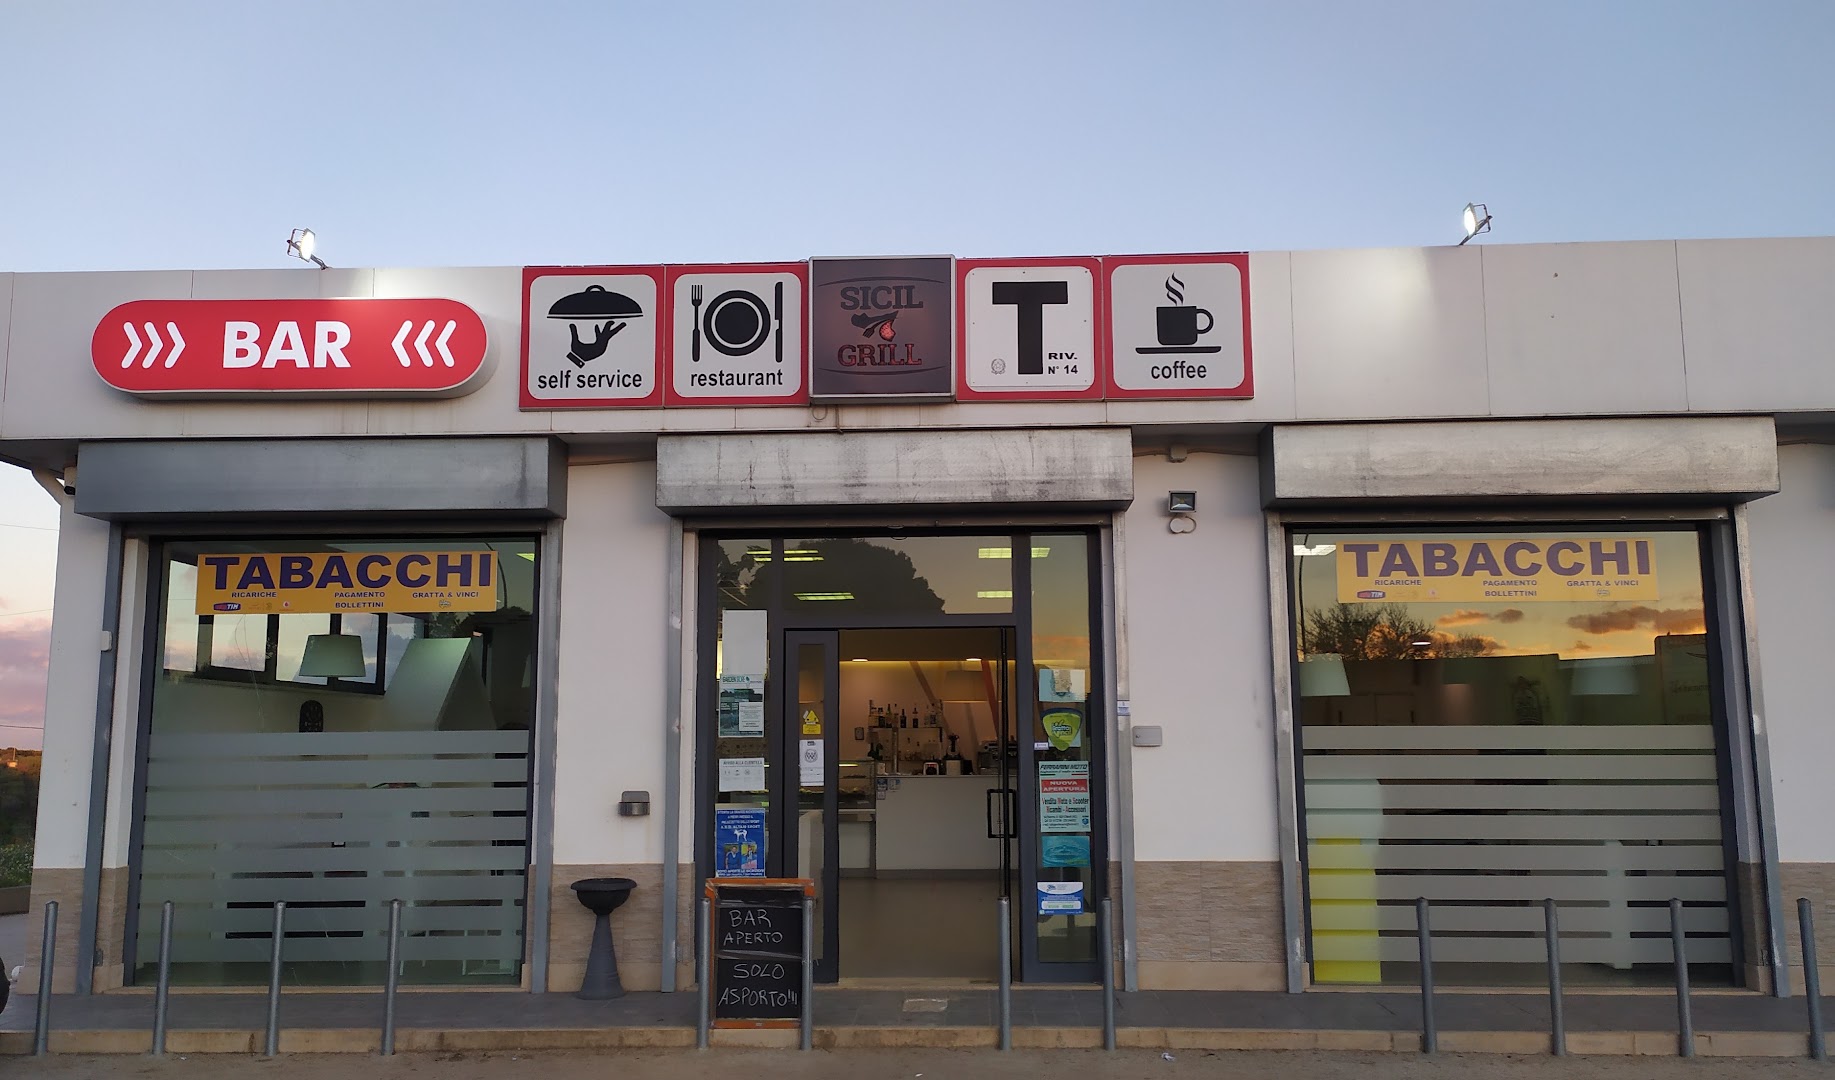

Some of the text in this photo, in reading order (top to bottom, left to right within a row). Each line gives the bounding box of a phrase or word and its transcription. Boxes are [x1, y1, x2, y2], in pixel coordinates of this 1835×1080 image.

[840, 284, 923, 311] SICIL
[992, 281, 1068, 374] T
[223, 321, 351, 368] BAR
[838, 343, 921, 368] GRILL
[1048, 352, 1078, 360] RIV.
[690, 370, 783, 387] restaurant
[1064, 364, 1078, 374] 14
[1150, 361, 1207, 380] coffee
[538, 370, 642, 389] self service
[1343, 540, 1651, 578] TABACCHI
[204, 553, 492, 590] TABACCHI
[729, 908, 772, 928] BAR
[723, 931, 783, 946] APERTO
[733, 963, 785, 979] SOLO
